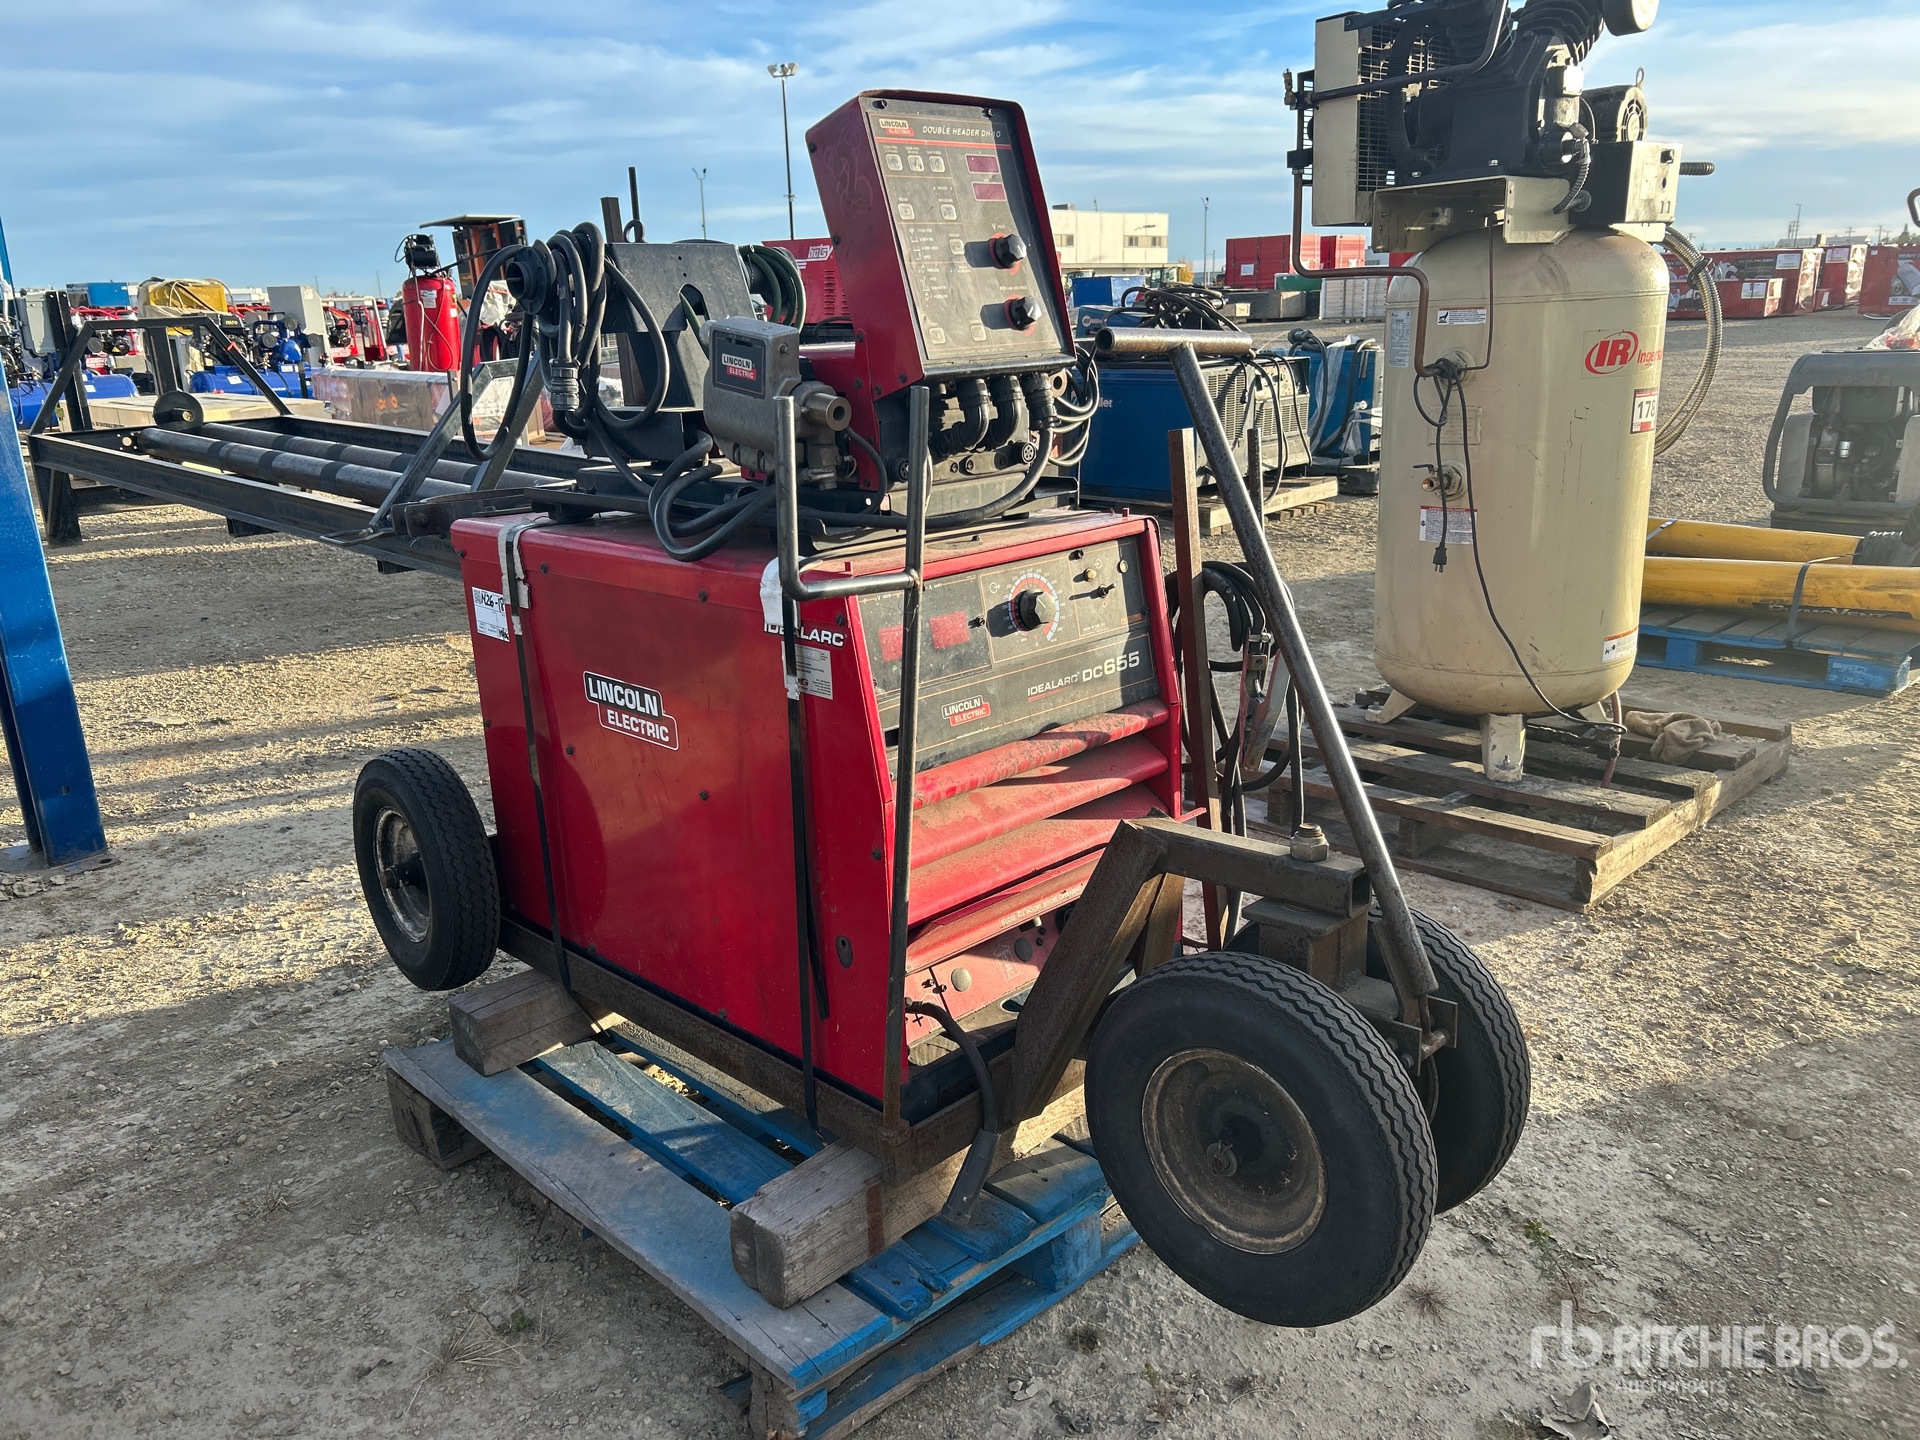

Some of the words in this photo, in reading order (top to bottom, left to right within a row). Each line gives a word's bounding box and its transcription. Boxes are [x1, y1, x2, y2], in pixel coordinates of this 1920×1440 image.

[880, 120, 907, 128] LINCOLN
[922, 125, 951, 135] DOUBLE
[952, 127, 980, 136] HEADER
[981, 129, 1001, 138] DH-10
[723, 354, 751, 369] LINCOLN
[1594, 338, 1631, 368] IR
[729, 367, 754, 379] ELECTRIC
[764, 623, 844, 646] IDLARC
[1027, 673, 1079, 696] IDEALARC
[1083, 650, 1140, 682] DC655
[588, 677, 659, 717] LINCOLN
[944, 698, 981, 717] LINCOLN
[955, 707, 987, 723] ELECTRIC
[607, 708, 670, 742] ELECTRIC
